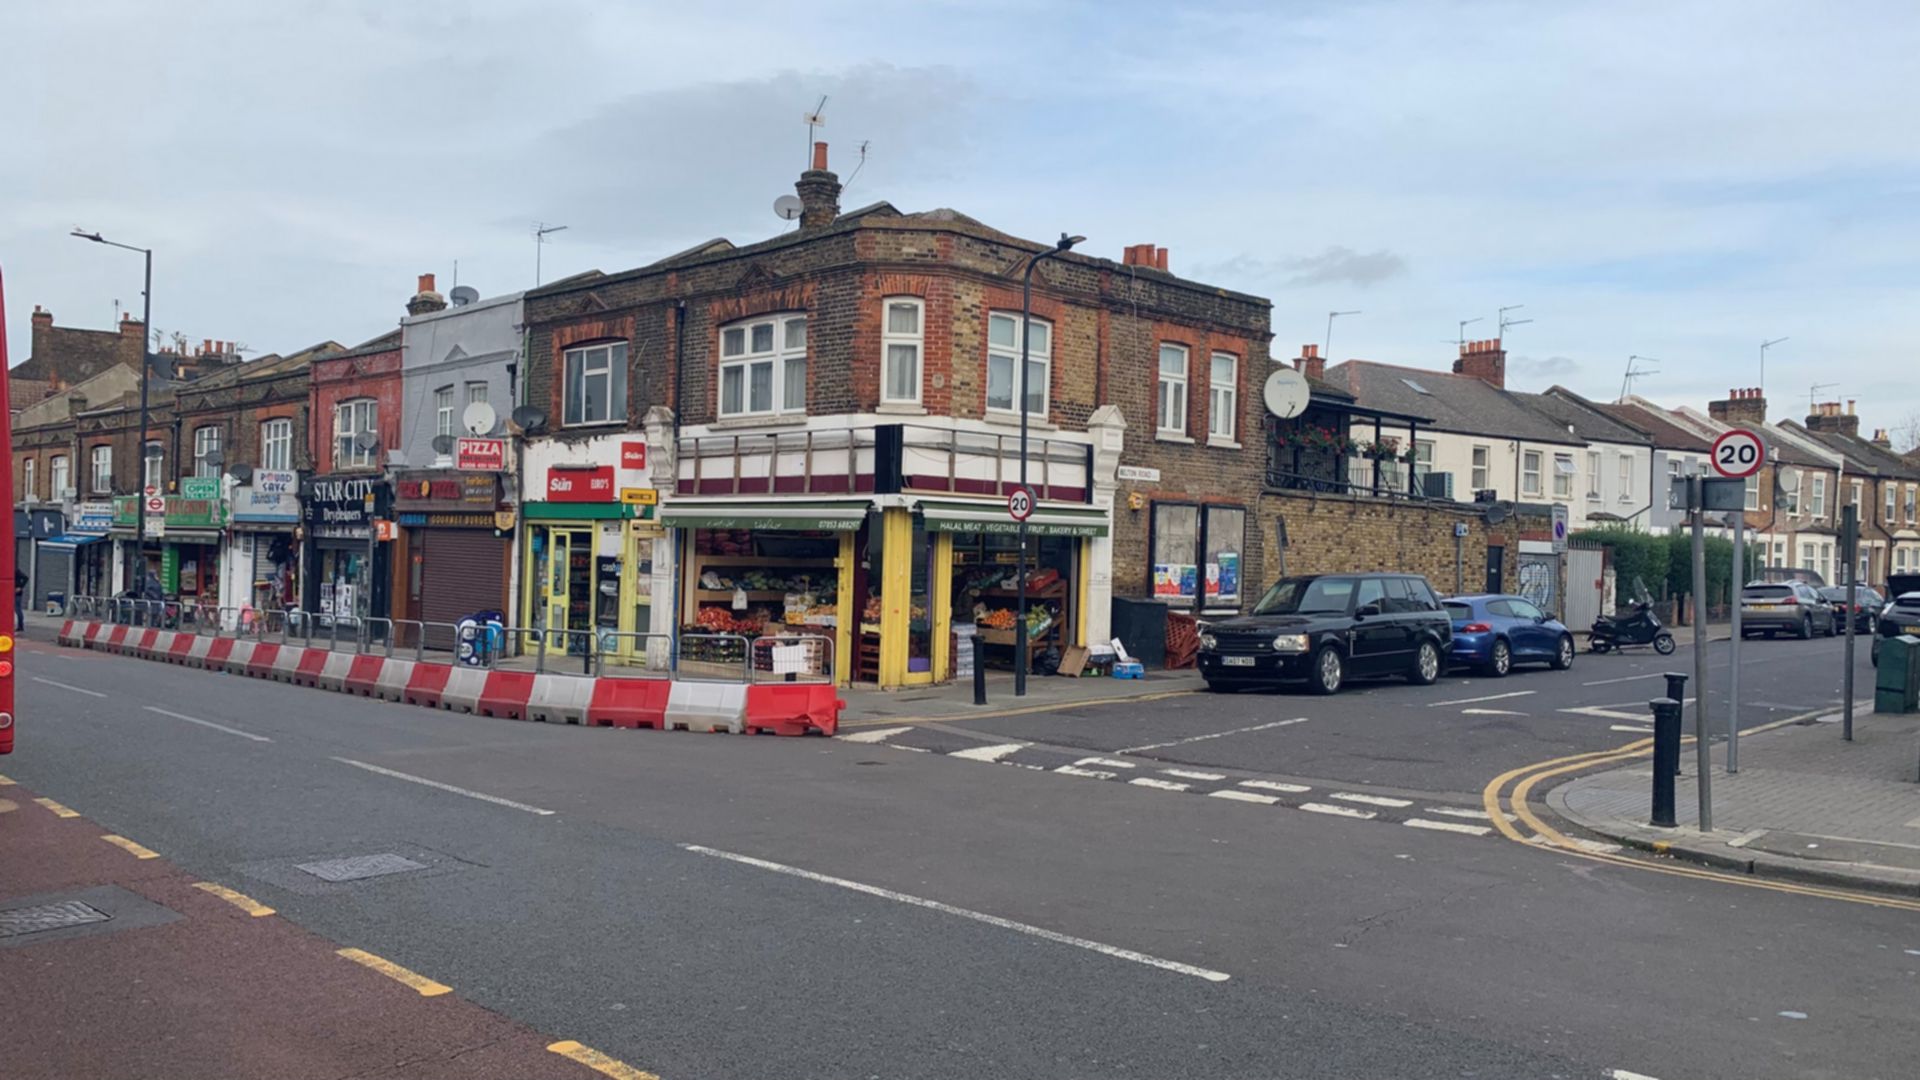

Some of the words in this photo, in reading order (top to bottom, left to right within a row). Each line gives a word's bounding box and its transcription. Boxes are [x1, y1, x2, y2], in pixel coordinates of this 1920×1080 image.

[459, 441, 500, 455] PIZZA
[1720, 445, 1756, 464] 20
[314, 481, 343, 502] STAR
[345, 479, 374, 501] CITY
[1012, 497, 1028, 511] 20
[940, 521, 962, 530] HALAL
[963, 522, 982, 531] MEAT
[985, 523, 1020, 533] VEGETABLE
[1028, 525, 1046, 534] FRUIT
[1049, 525, 1071, 535] BAKERY
[1078, 527, 1098, 536] SWEET
